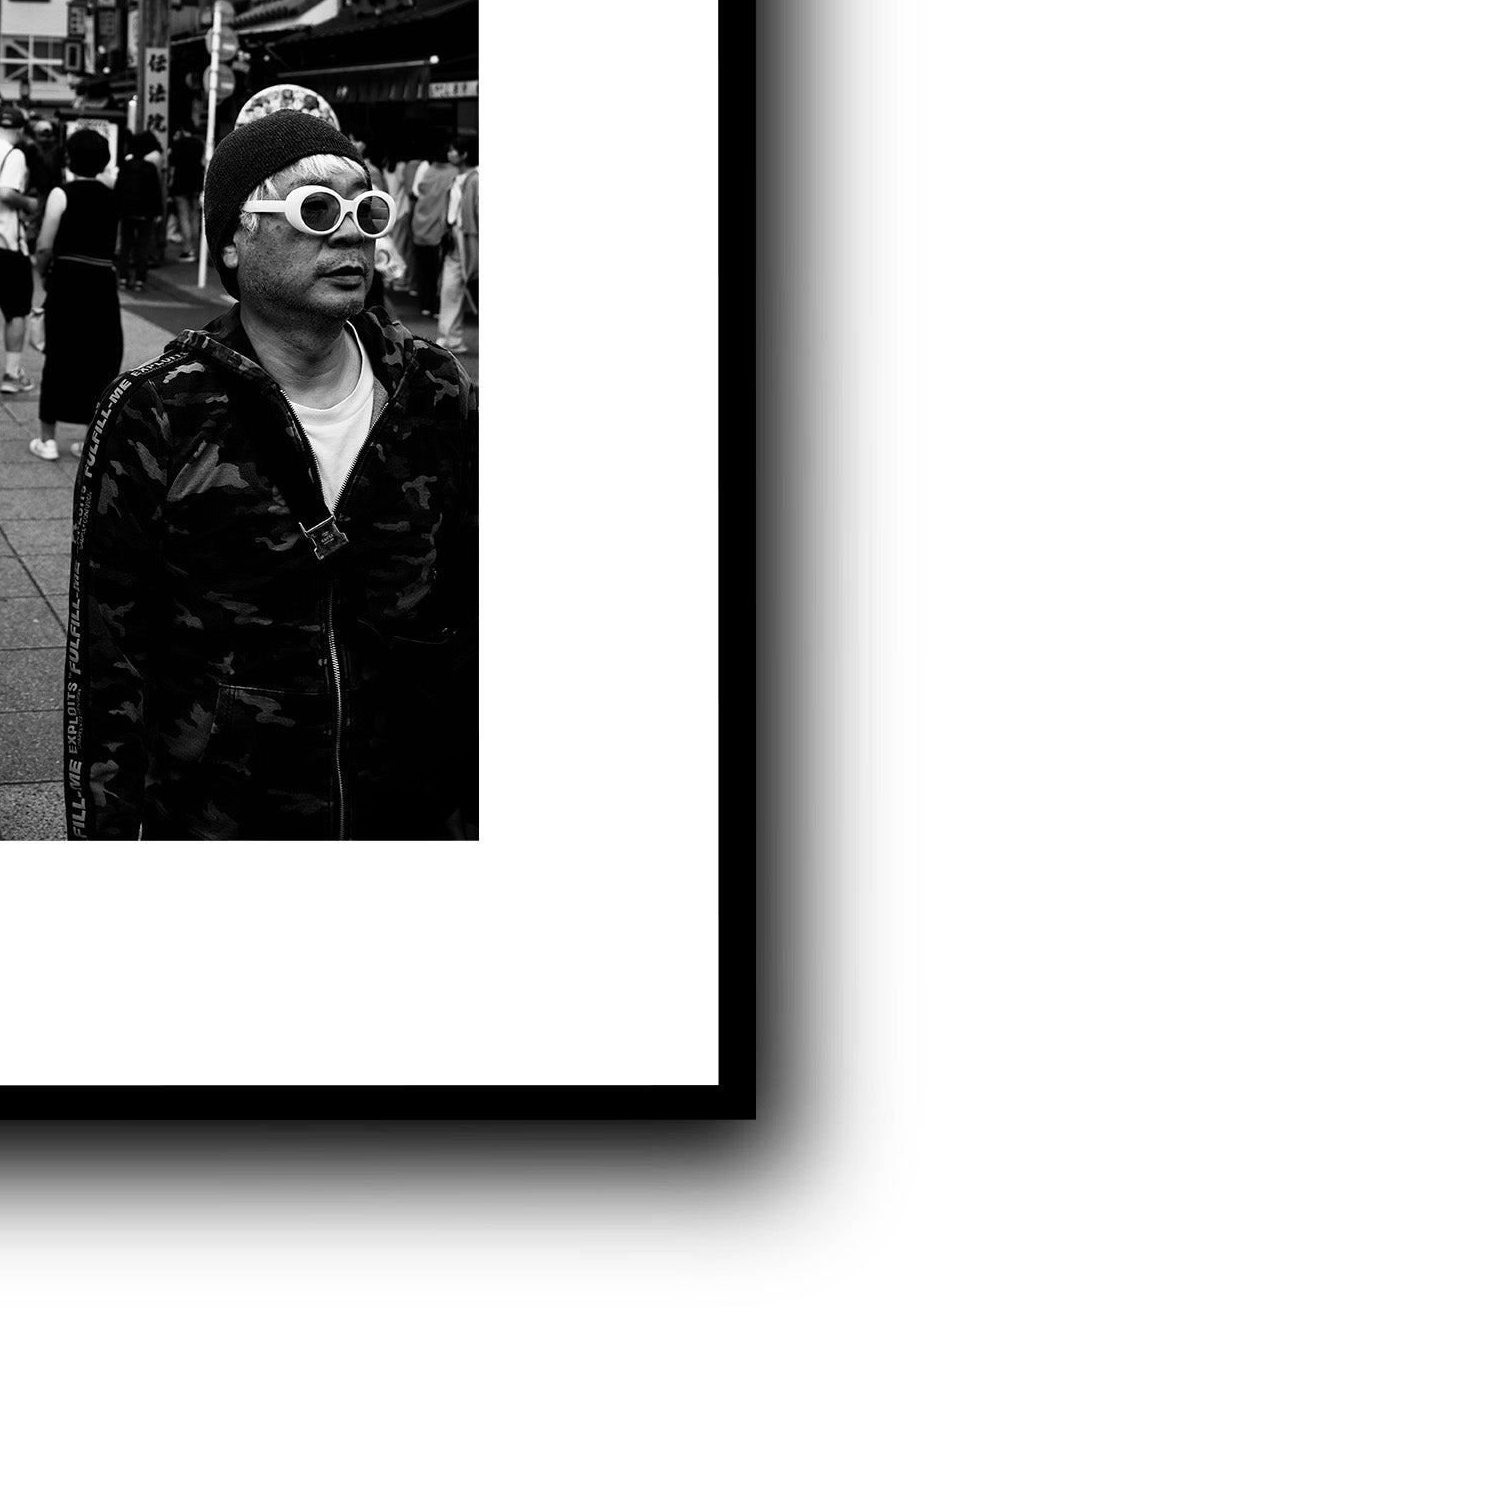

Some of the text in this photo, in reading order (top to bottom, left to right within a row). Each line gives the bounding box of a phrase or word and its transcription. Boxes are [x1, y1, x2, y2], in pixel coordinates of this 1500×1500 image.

[84, 378, 132, 478] FULFILL-ME
[68, 562, 81, 675] FULFILL-ME
[67, 682, 79, 754] EXPLOITS
